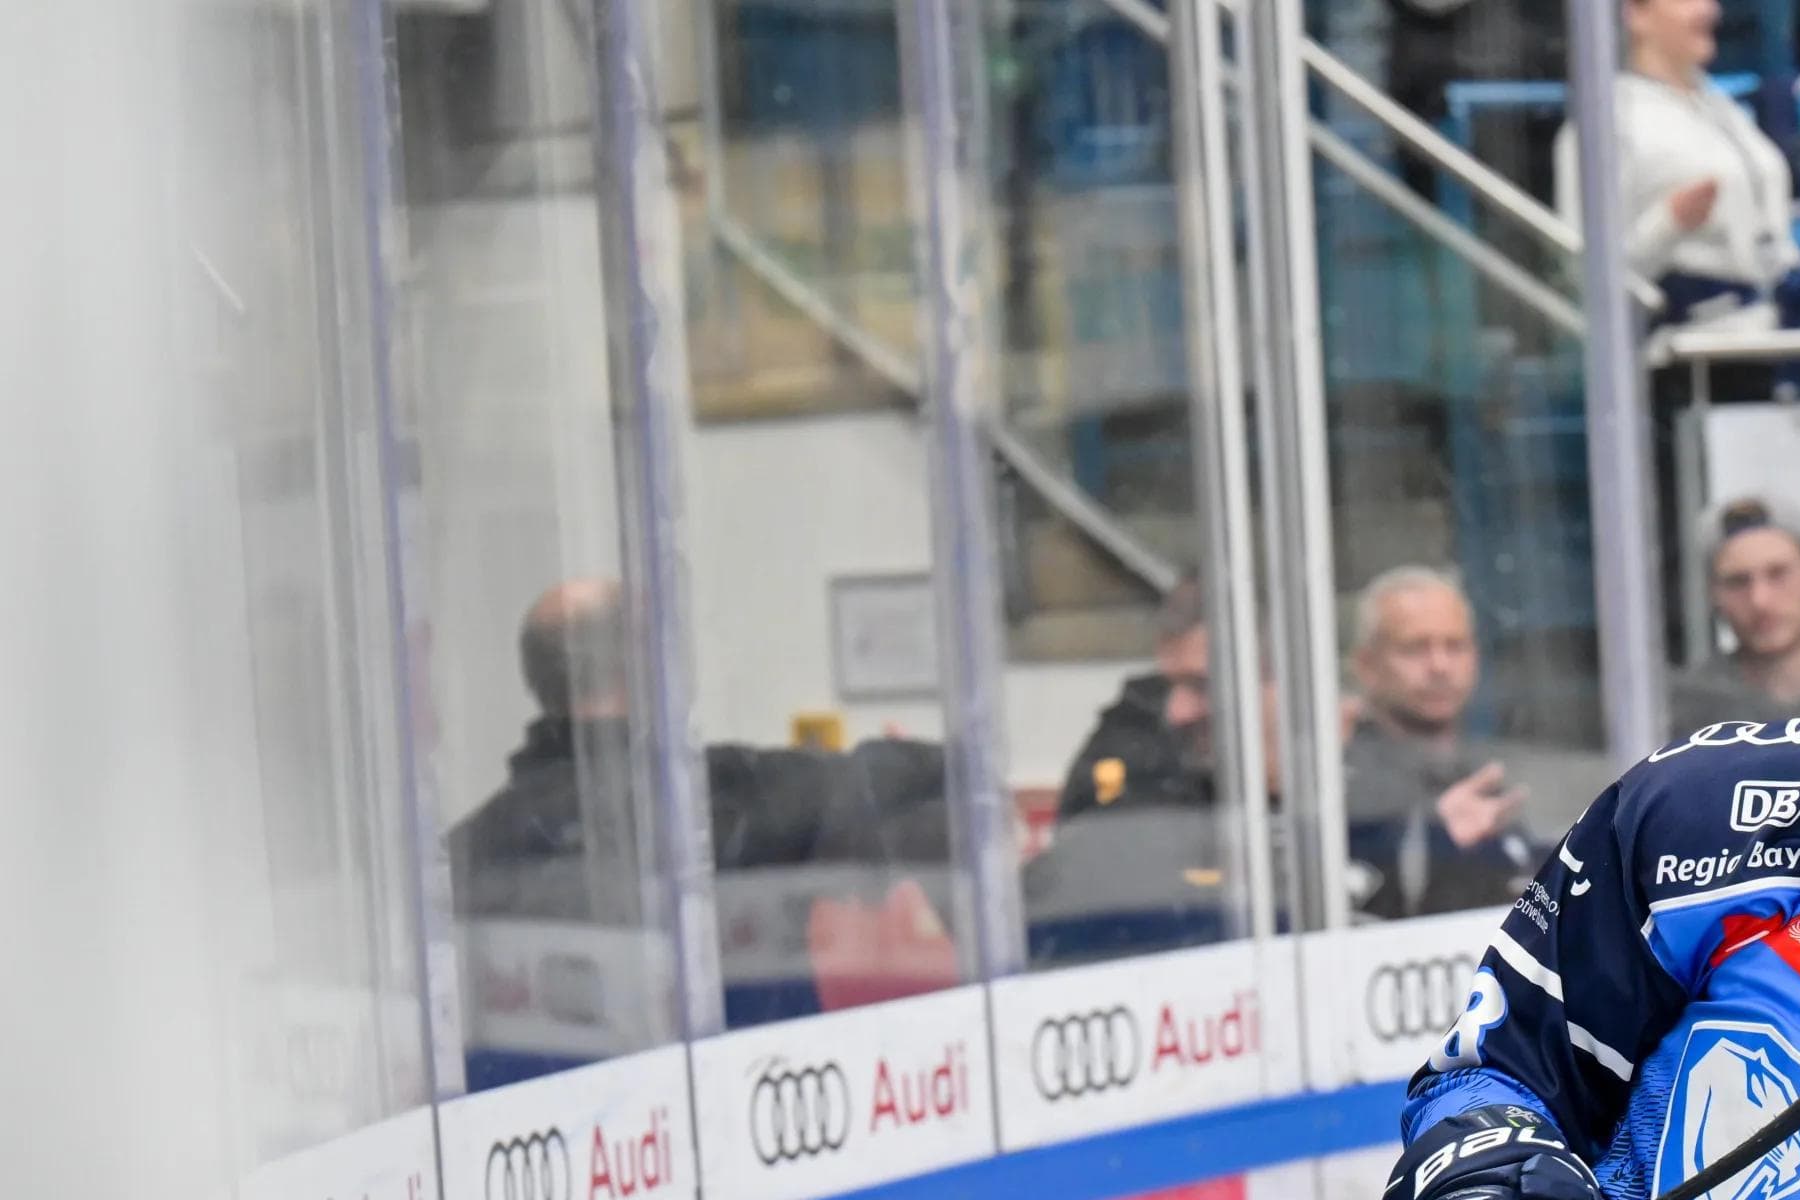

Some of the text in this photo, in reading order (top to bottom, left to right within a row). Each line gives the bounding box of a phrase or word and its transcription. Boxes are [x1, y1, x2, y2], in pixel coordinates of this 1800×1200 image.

[1740, 788, 1800, 825] DB
[1656, 848, 1744, 887] Regio
[1151, 987, 1263, 1073] Audi
[869, 1042, 968, 1135] Audi
